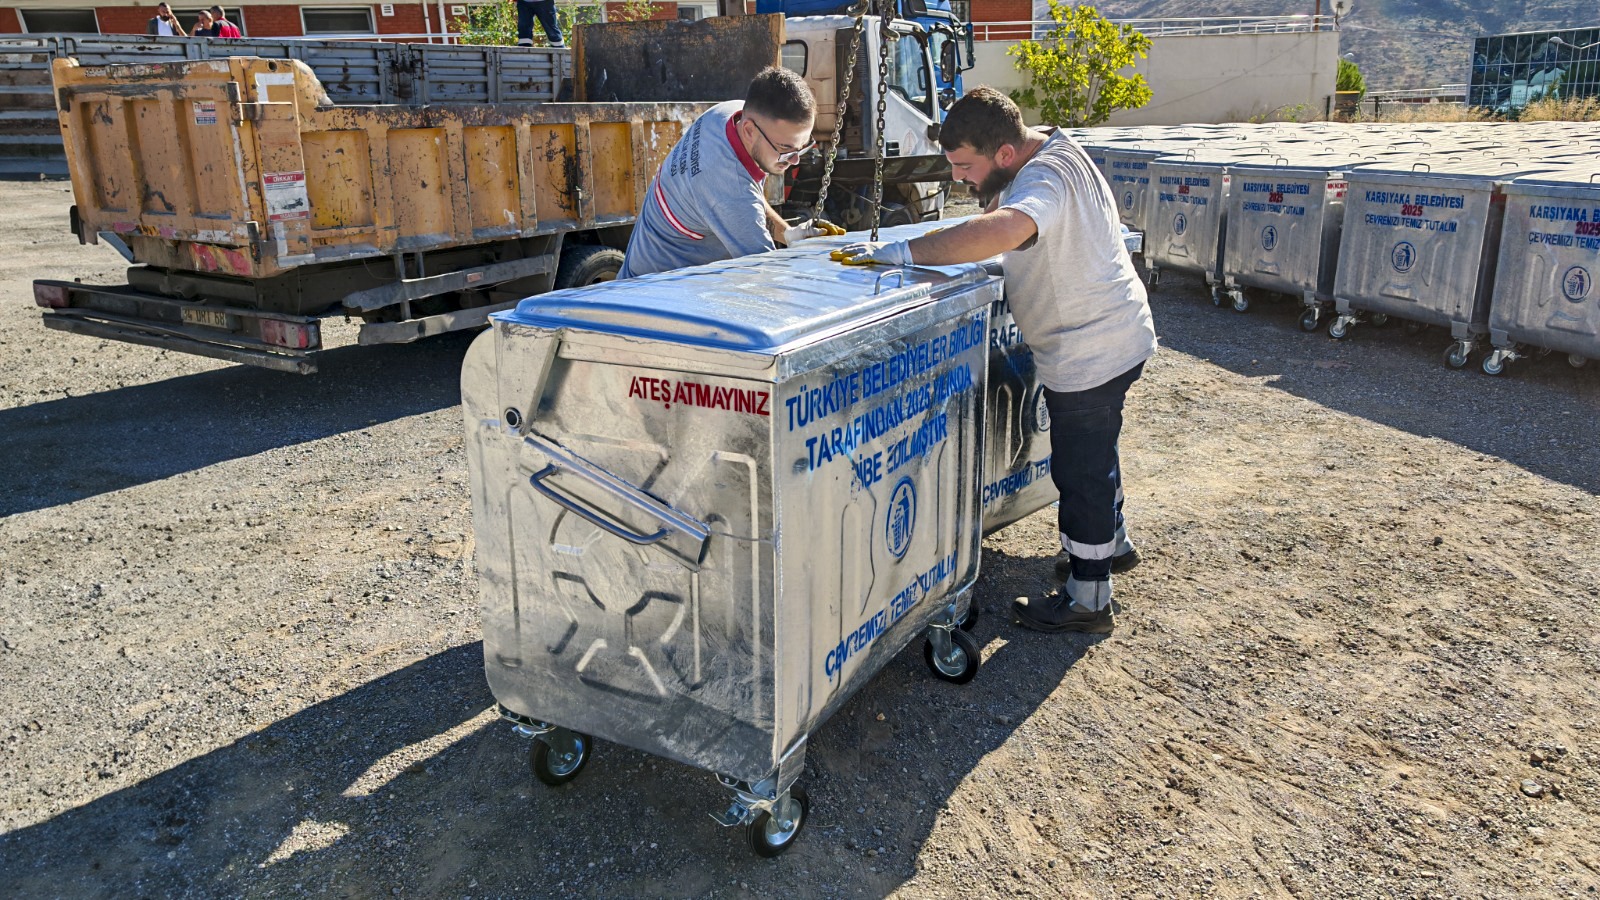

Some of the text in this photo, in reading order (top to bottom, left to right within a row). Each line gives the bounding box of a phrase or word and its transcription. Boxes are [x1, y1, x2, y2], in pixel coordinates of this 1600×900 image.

[1243, 182, 1274, 194] KARŞIYAKA
[1268, 192, 1284, 203] 2025
[1365, 190, 1410, 205] KARŞIYAKA
[1415, 193, 1465, 209] BELEDİYESİ
[1401, 204, 1424, 217] 2025
[1529, 205, 1587, 223] KARŞIYAKA
[1425, 219, 1457, 233] TUTALIM
[786, 373, 858, 431] TÜRKİYE
[863, 335, 947, 398] BELEDİYELER
[949, 313, 985, 358] BİRLİĞİ
[629, 376, 770, 416] ATEŞ ATMAYINIZ
[805, 396, 904, 471] TARAFINDAN
[906, 383, 931, 419] 2025
[983, 467, 1032, 508] ÇEVREMİZİ
